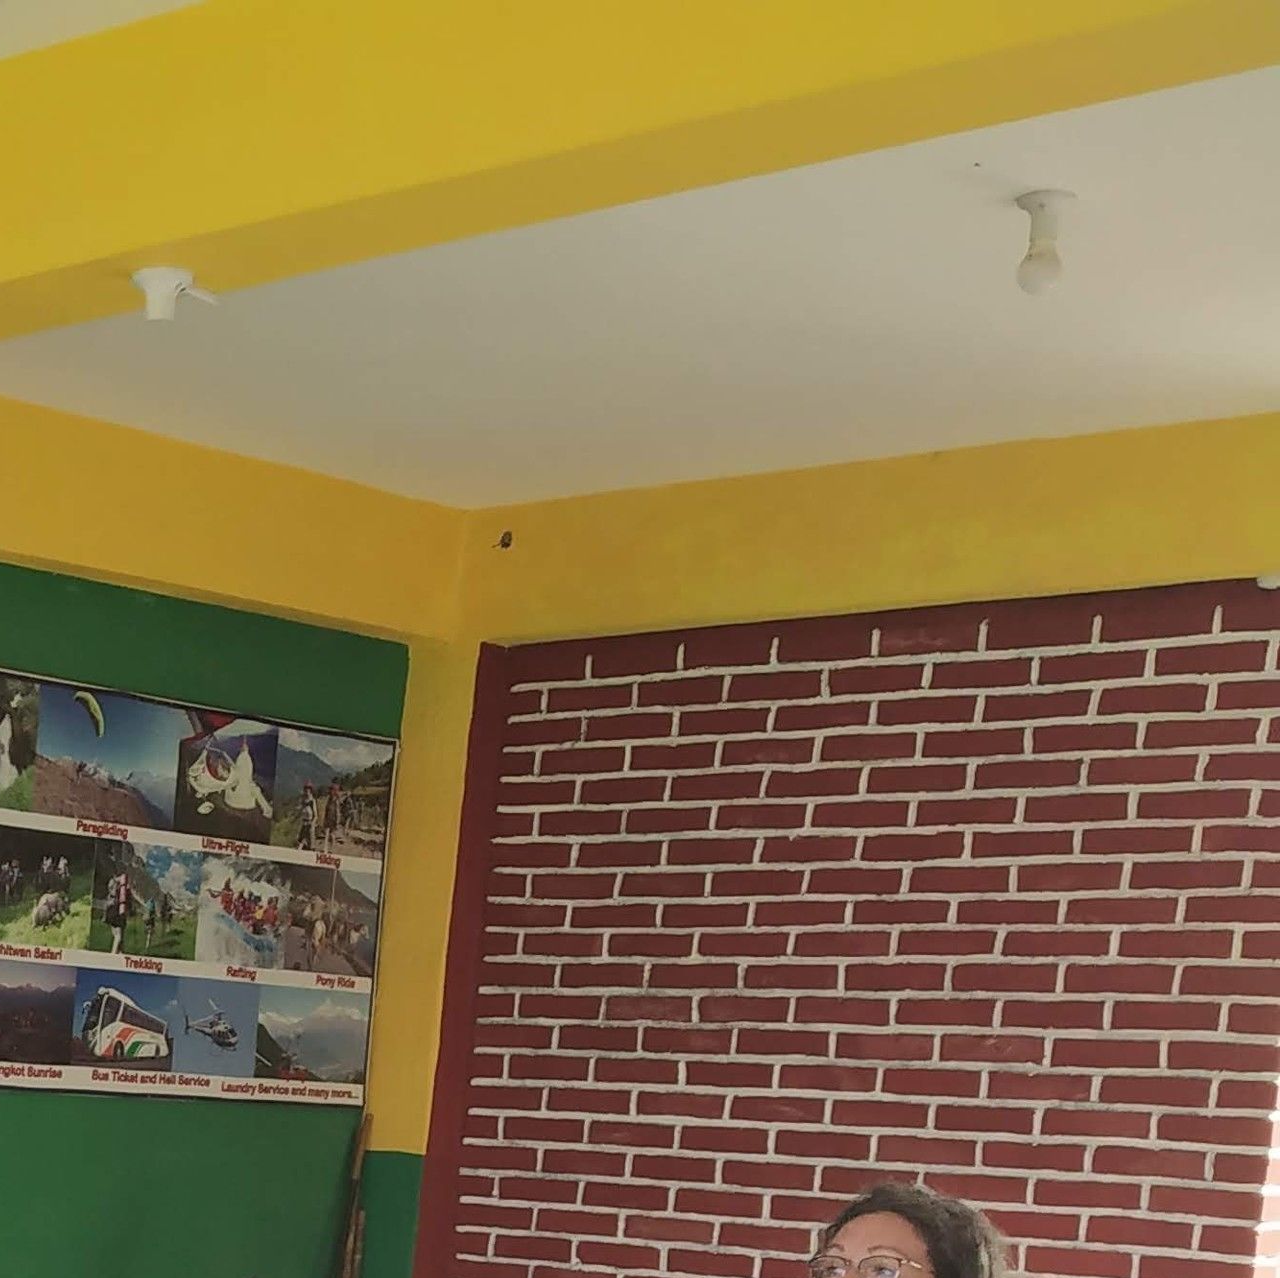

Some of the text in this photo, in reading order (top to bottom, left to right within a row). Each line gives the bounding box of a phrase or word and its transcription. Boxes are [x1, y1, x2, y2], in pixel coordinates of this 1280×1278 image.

[76, 820, 128, 840] Paragliding
[33, 946, 63, 961] Safari
[124, 956, 163, 973] Trekking
[226, 965, 257, 982] Rafting
[27, 1065, 63, 1079] Sunrise
[91, 1069, 110, 1082] Bus
[111, 1070, 139, 1084] Ticket
[140, 1073, 158, 1085] and
[178, 1074, 212, 1088] Service
[221, 1081, 257, 1096] Laundry
[258, 1083, 291, 1097] Service
